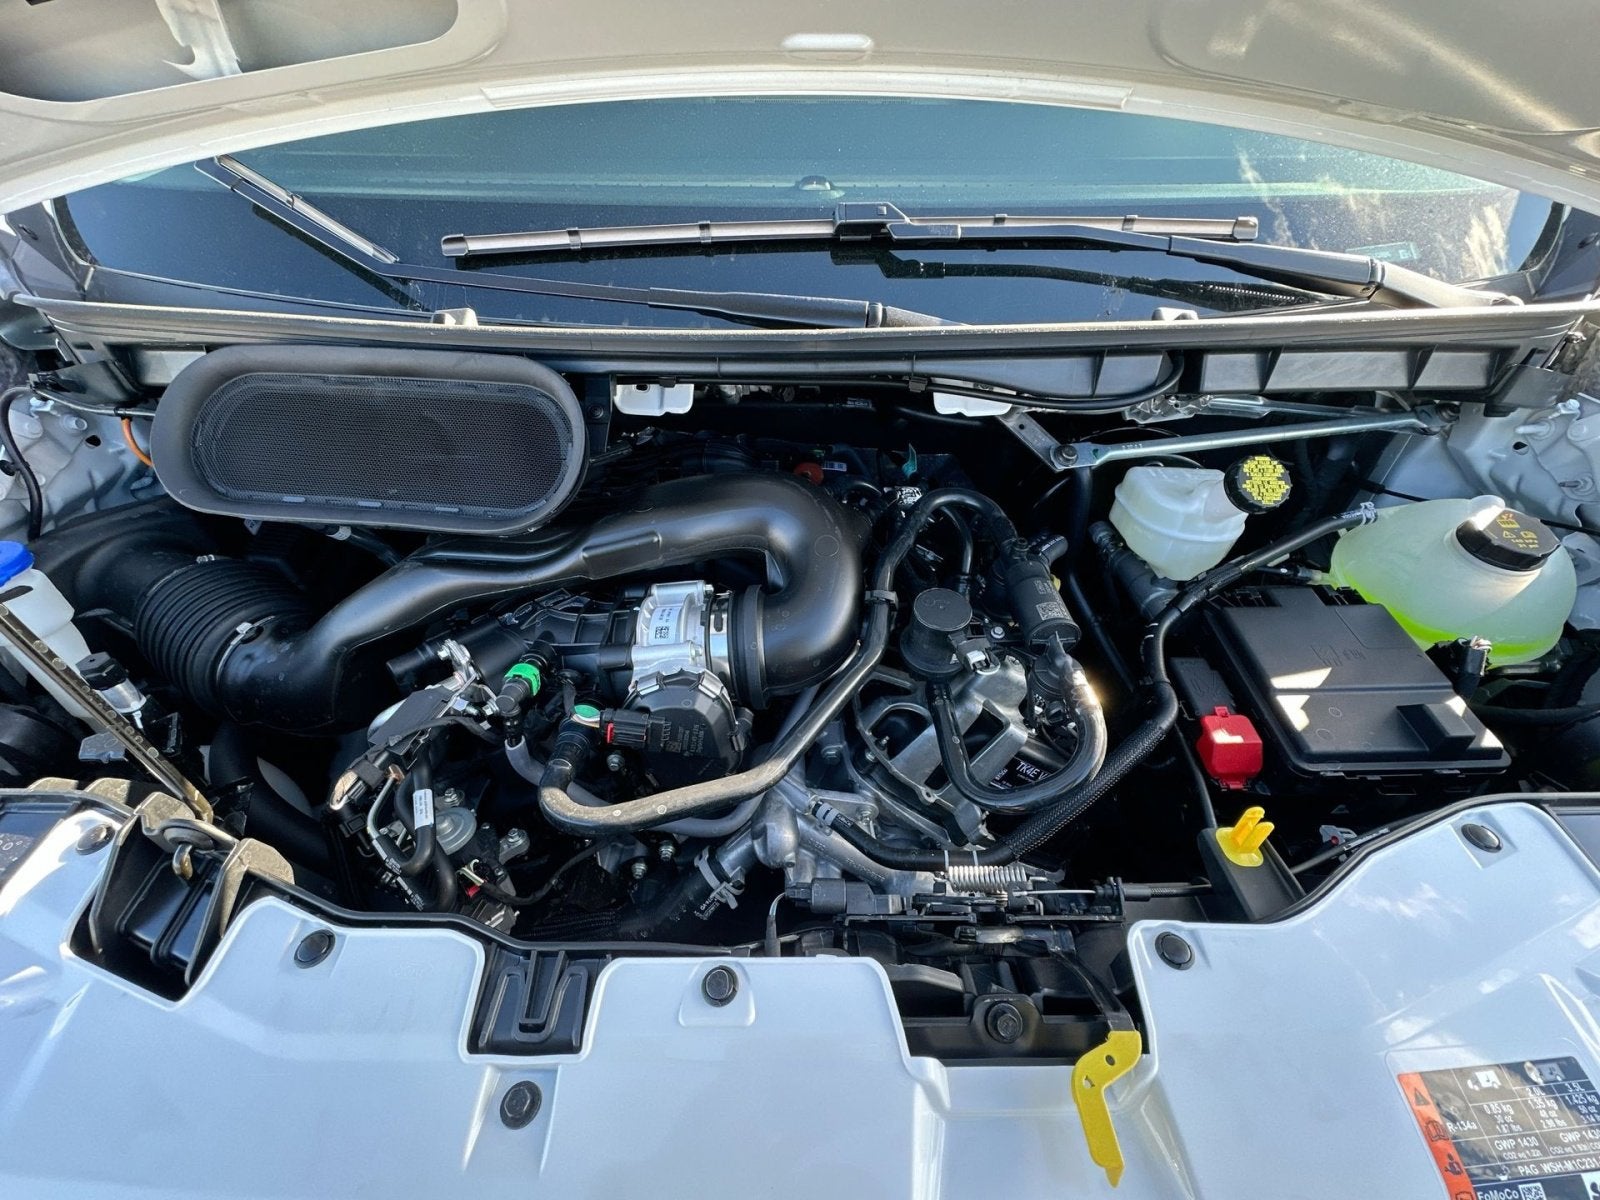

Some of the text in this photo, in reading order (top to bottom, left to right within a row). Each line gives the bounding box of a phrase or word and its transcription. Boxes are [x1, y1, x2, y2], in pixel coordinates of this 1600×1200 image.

[1544, 1096, 1558, 1110] kg
[1584, 1092, 1599, 1105] kg
[1500, 1103, 1514, 1115] kg
[1446, 1120, 1478, 1134] R-134a
[1494, 1136, 1540, 1150] GWP 1430
[1560, 1131, 1581, 1143] GWP
[1503, 1152, 1518, 1160] CO2
[1549, 1146, 1564, 1155] CO2
[1517, 1164, 1540, 1177] PAG
[1476, 1188, 1519, 1200] FoMoCo
